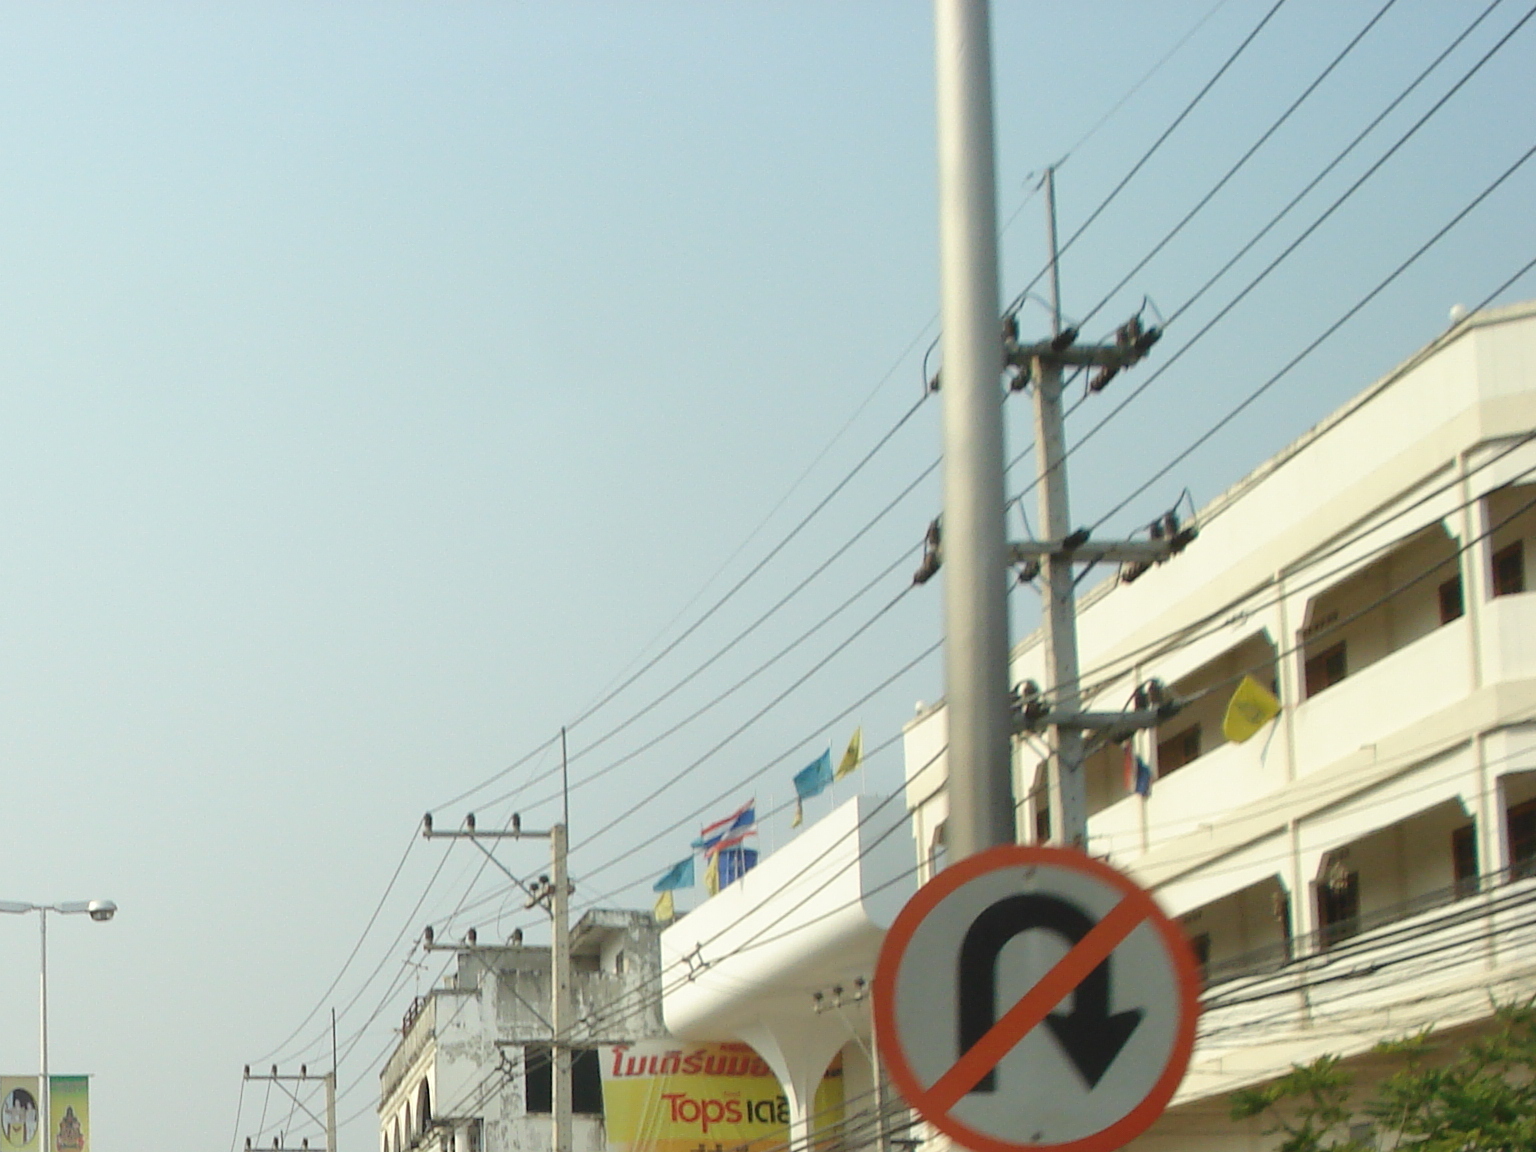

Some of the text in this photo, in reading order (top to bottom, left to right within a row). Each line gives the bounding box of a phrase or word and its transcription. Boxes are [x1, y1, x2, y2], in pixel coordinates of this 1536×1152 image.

[611, 1045, 776, 1077] โมเดิร์นมอ
[661, 1092, 743, 1134] Tops
